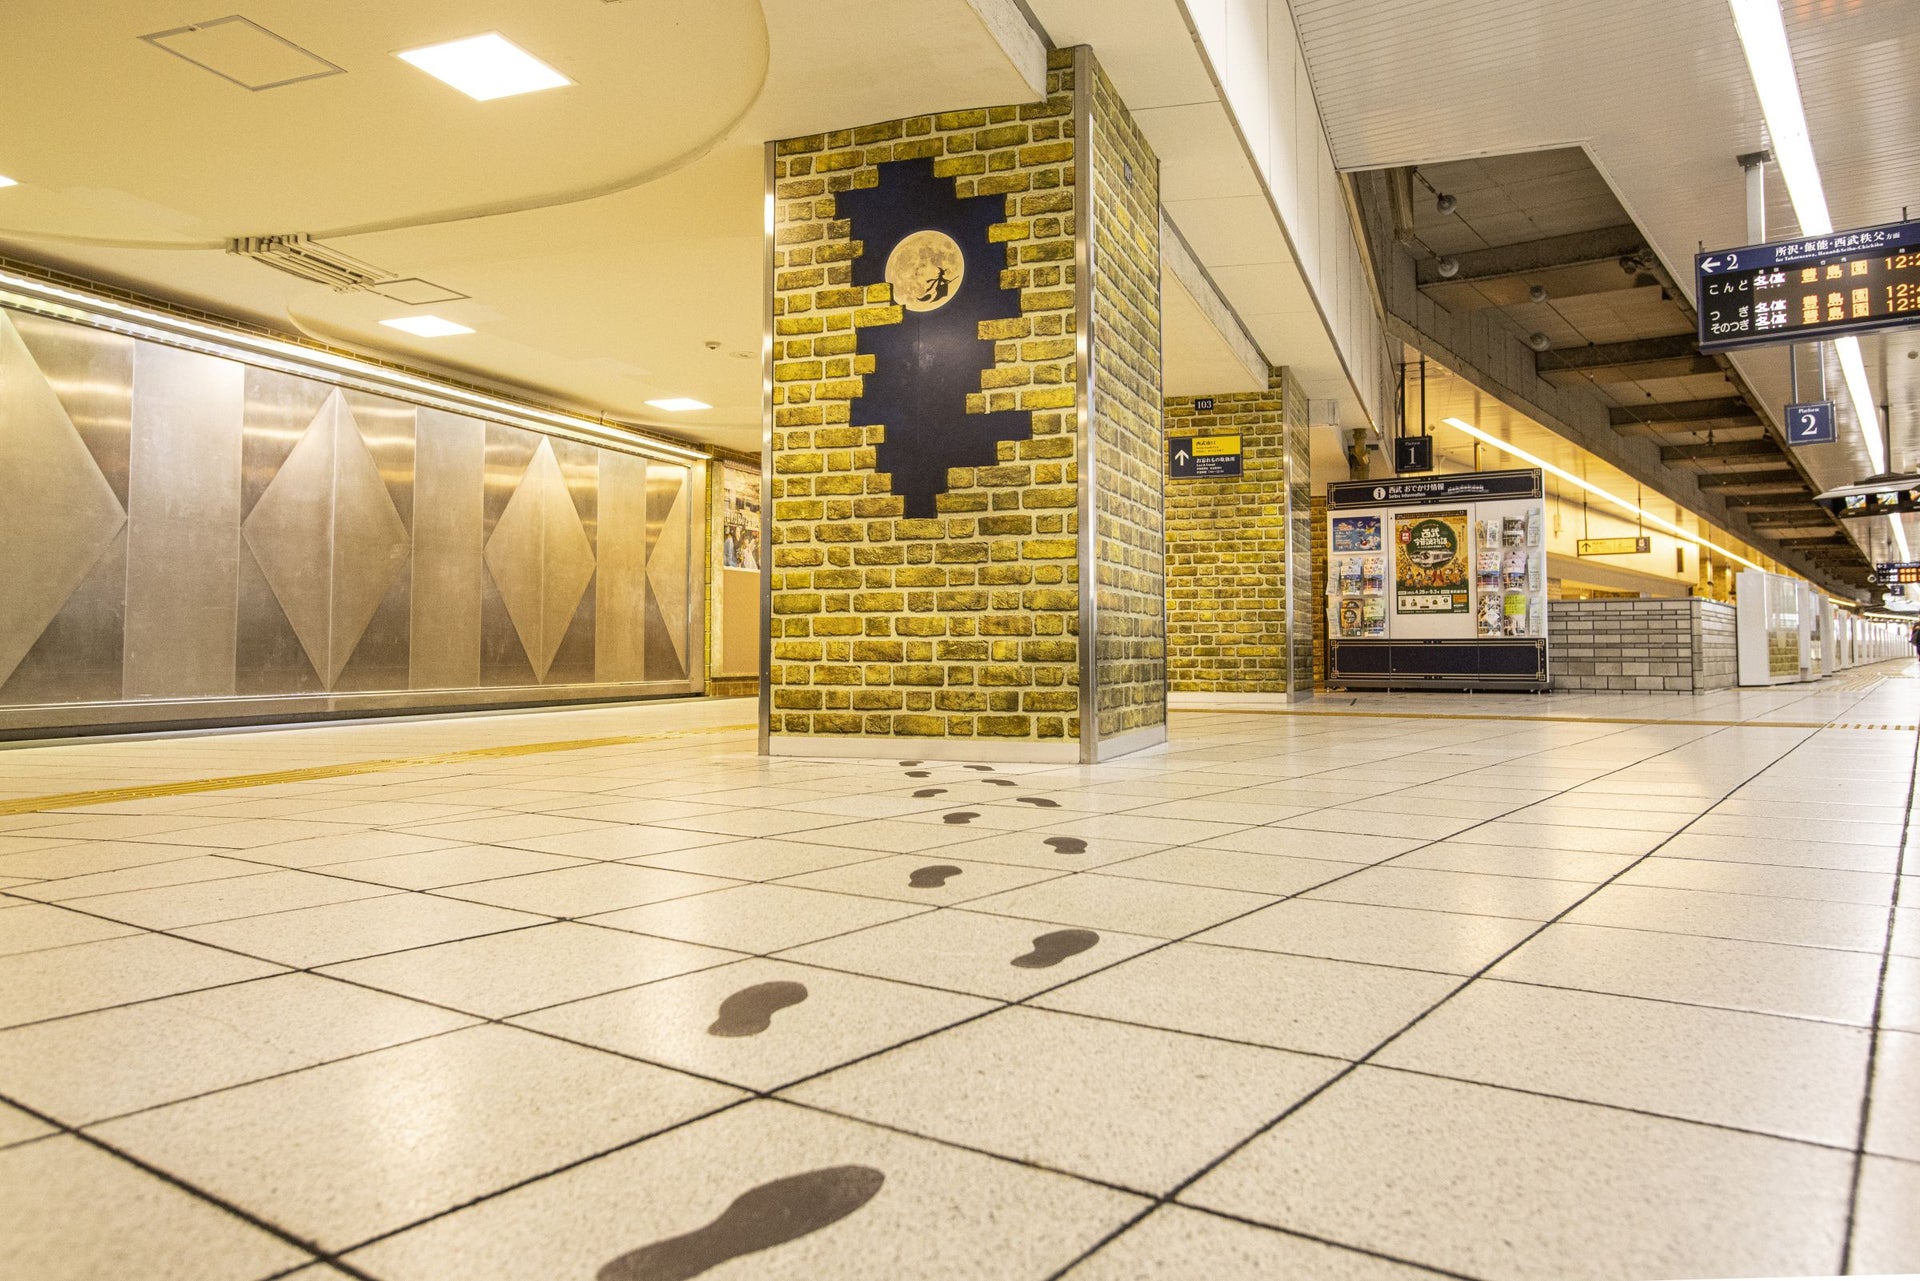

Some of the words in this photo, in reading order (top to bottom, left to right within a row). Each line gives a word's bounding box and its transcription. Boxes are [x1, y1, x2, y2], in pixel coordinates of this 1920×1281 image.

[1726, 254, 1738, 270] 2
[1709, 279, 1748, 296] こんど
[1710, 319, 1750, 334] そのつぎ
[1197, 400, 1212, 409] 103
[1801, 414, 1818, 436] 2
[1408, 446, 1416, 464] 1
